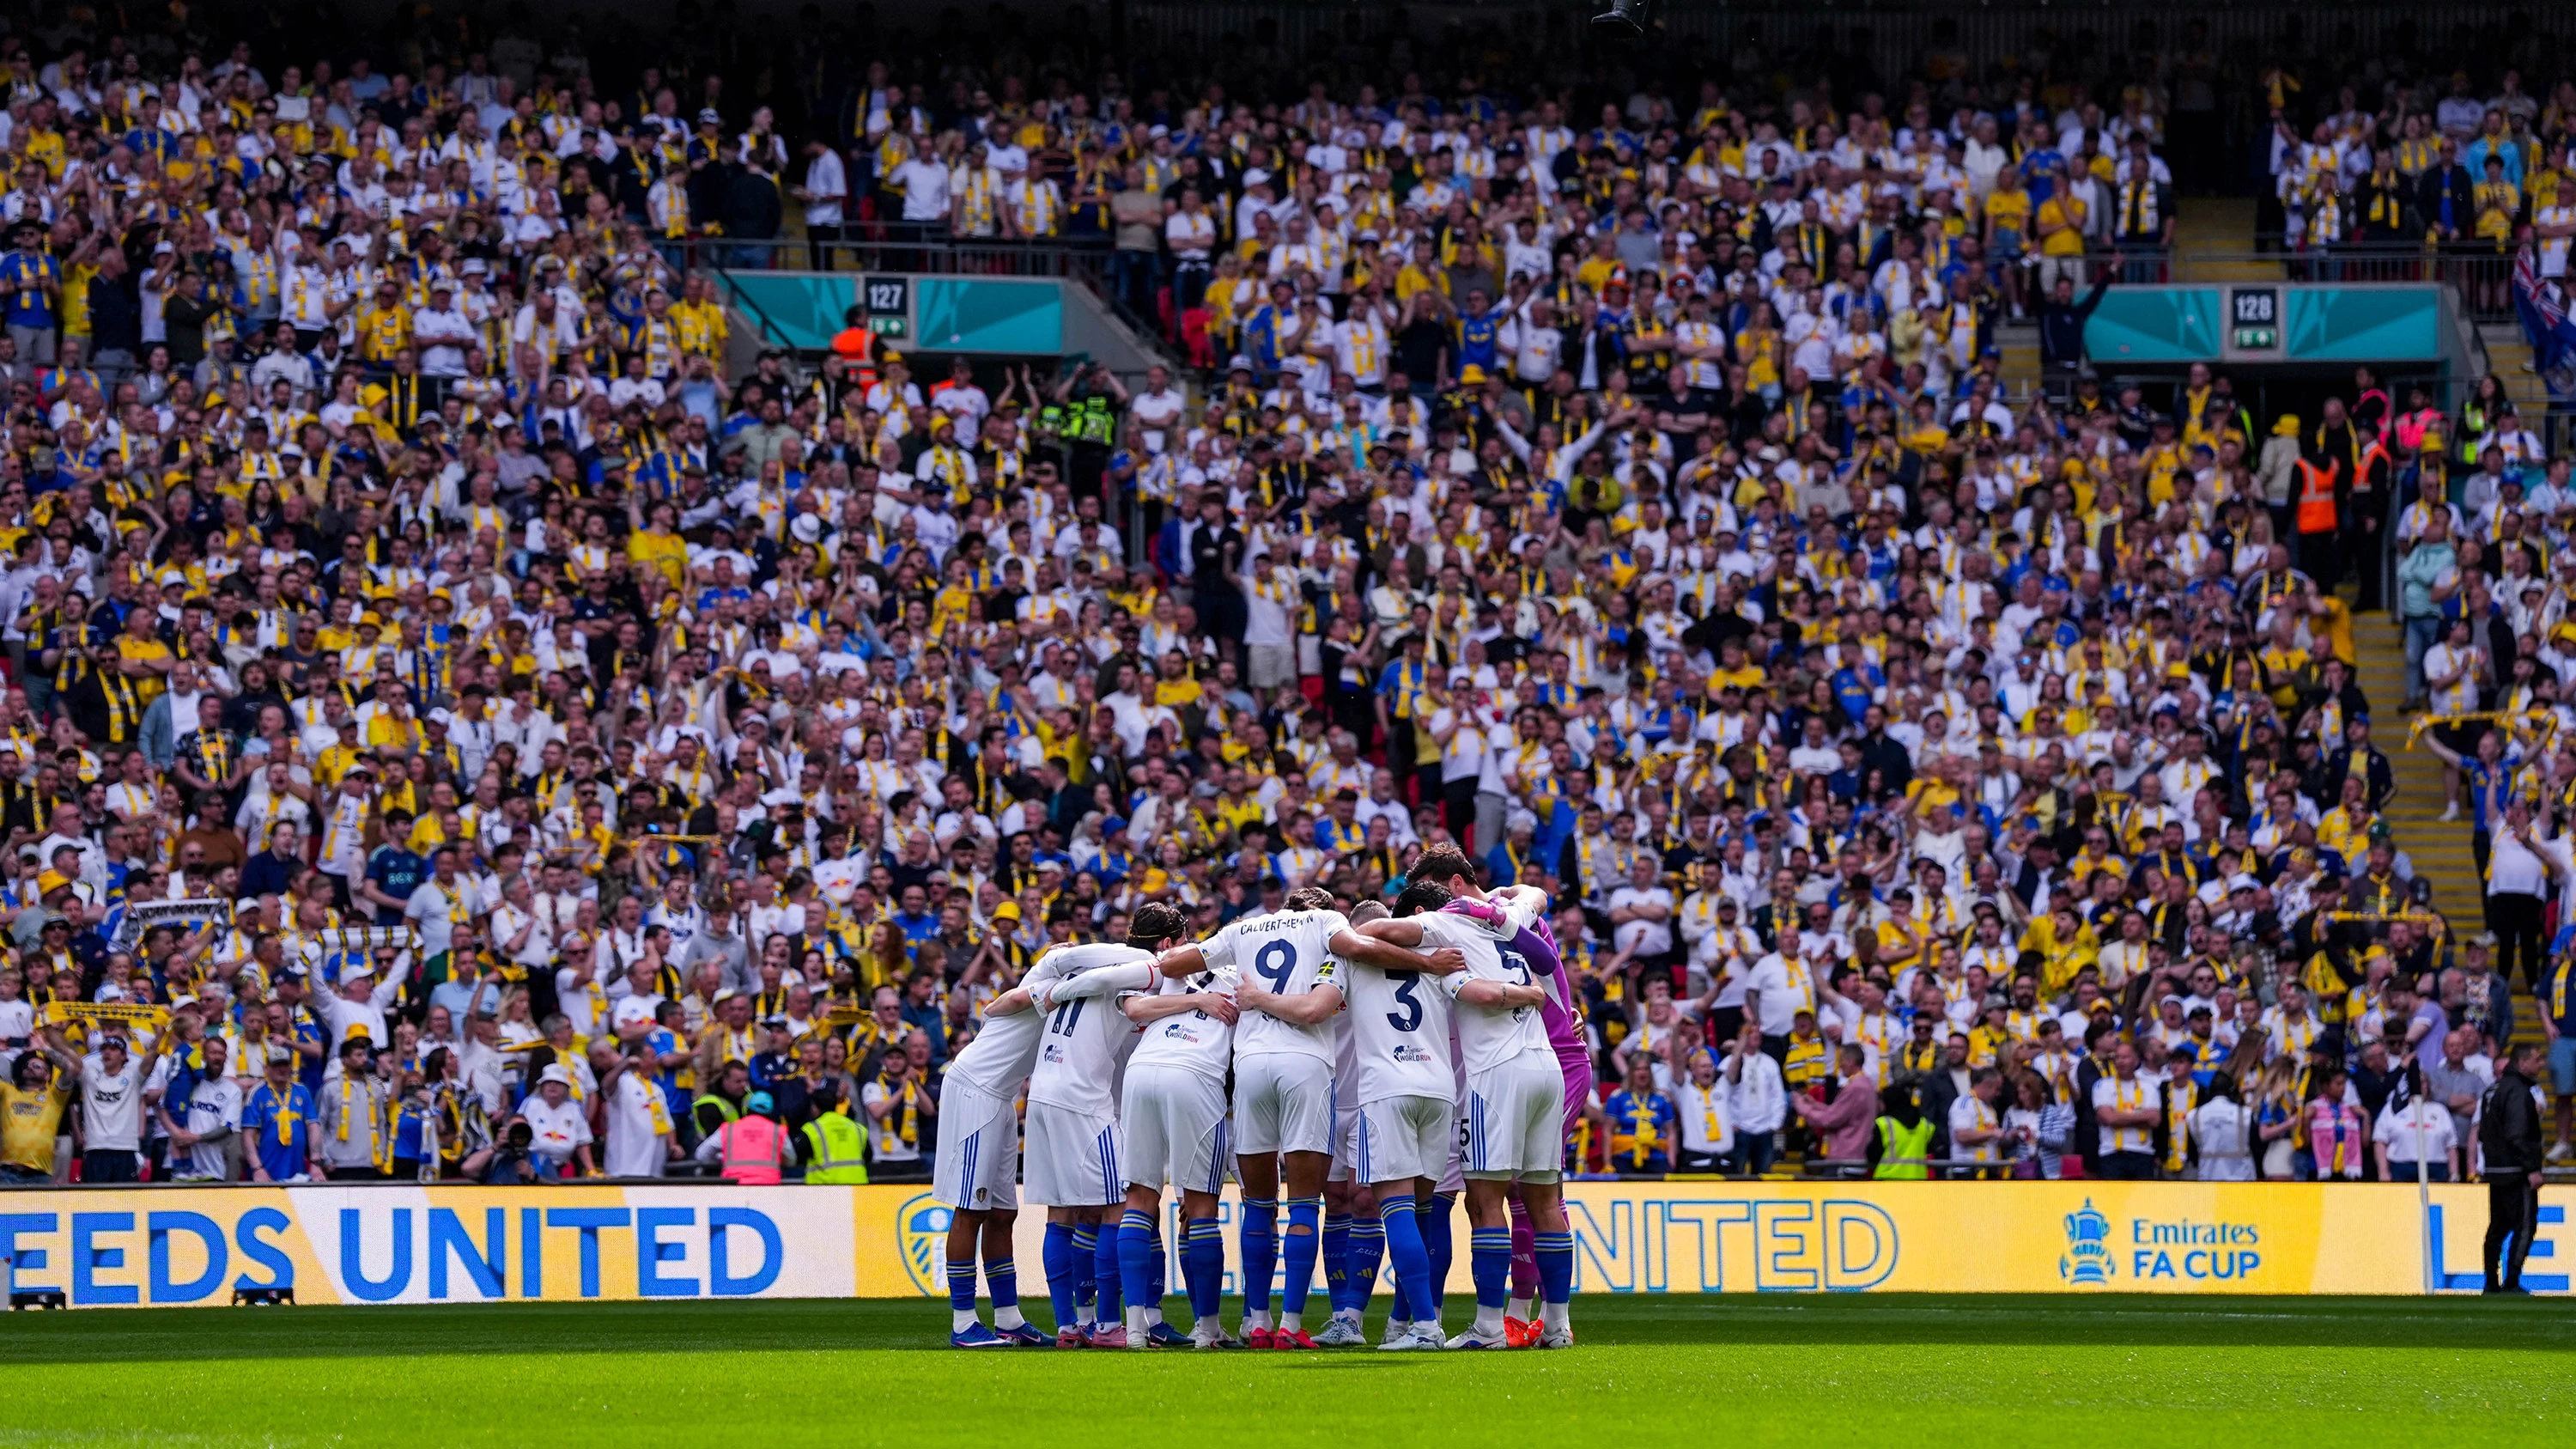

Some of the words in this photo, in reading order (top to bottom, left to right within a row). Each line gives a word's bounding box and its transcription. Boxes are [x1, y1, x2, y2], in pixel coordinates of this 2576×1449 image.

[868, 283, 902, 309] 127
[2235, 294, 2273, 320] 128
[1255, 938, 1297, 995] 9
[1384, 969, 1423, 1032] 3
[1509, 1200, 1898, 1293] NITED
[2133, 1218, 2259, 1245] Emirates
[340, 1207, 784, 1300] UNITED
[2133, 1251, 2177, 1279] FA
[2184, 1251, 2261, 1279] CUP
